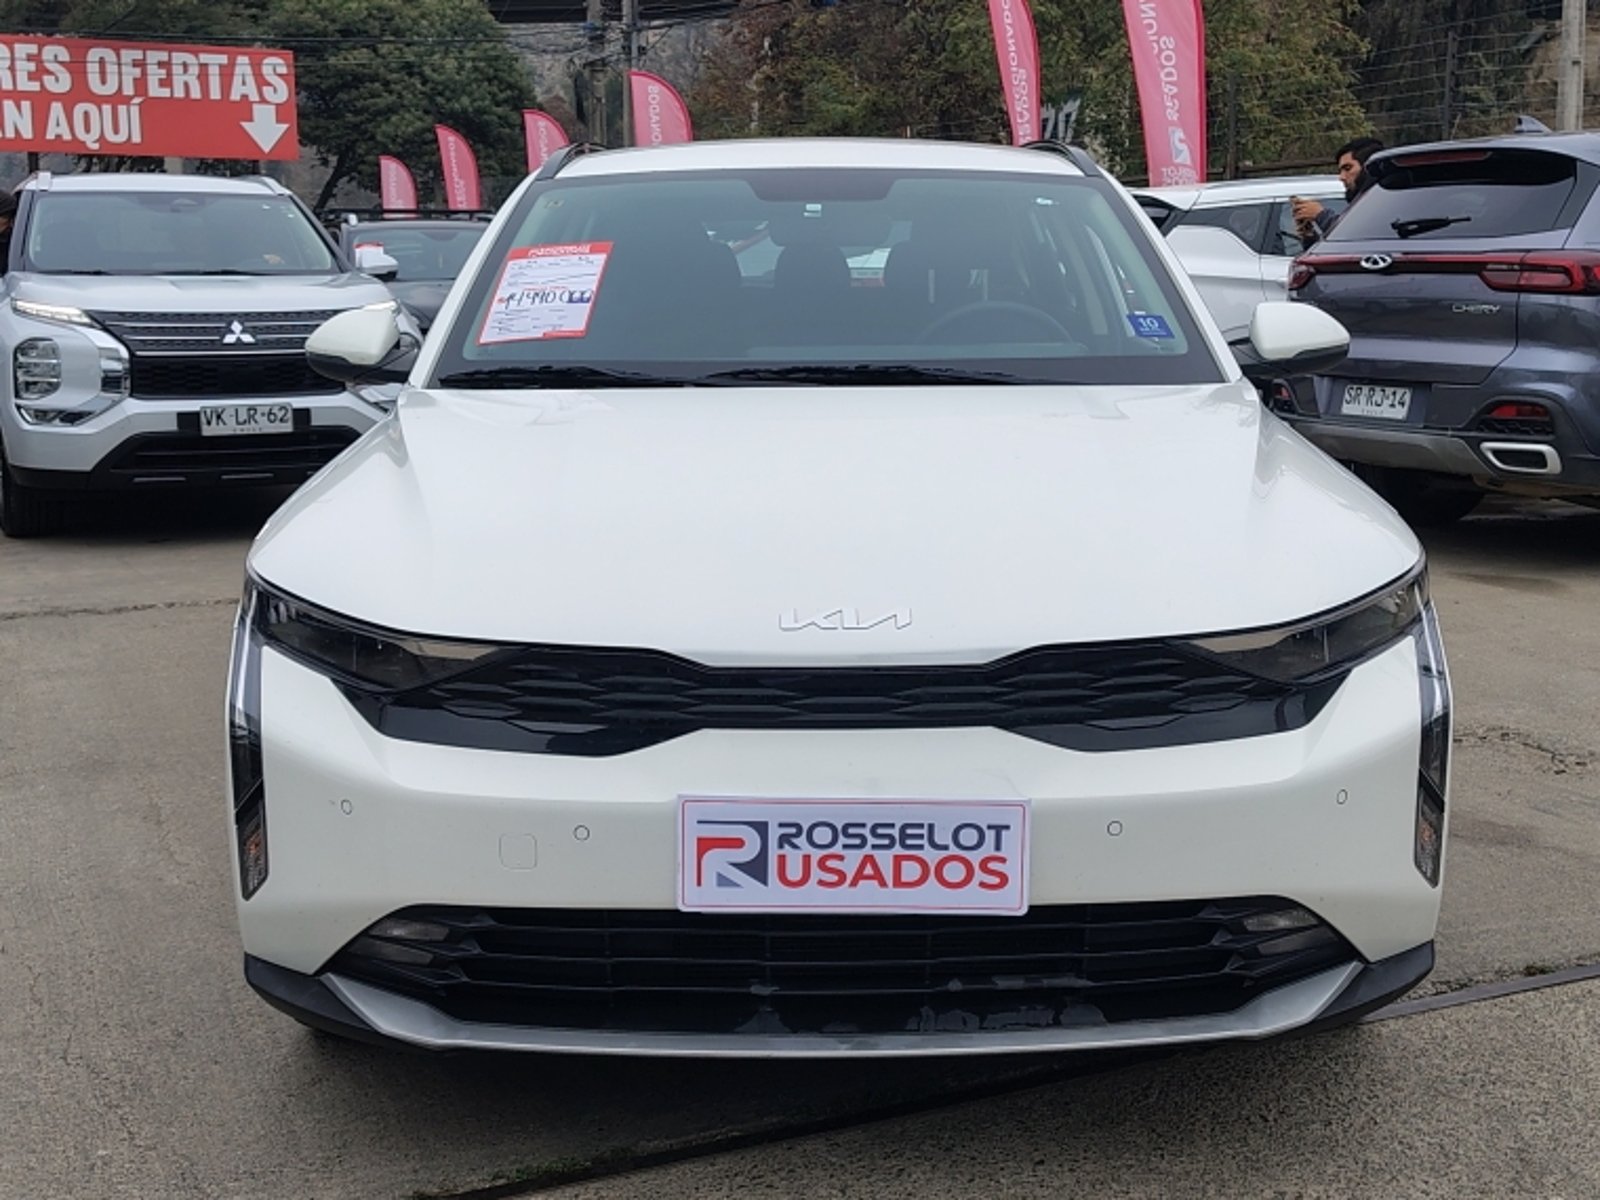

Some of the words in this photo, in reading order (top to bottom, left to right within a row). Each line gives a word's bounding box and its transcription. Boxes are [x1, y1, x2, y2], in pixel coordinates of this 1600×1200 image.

[86, 47, 289, 104] OFERTAS
[0, 99, 34, 140] N
[45, 96, 146, 150] AQUÍ
[777, 820, 1011, 851] ROSSELOT
[776, 853, 1010, 891] USADOS
